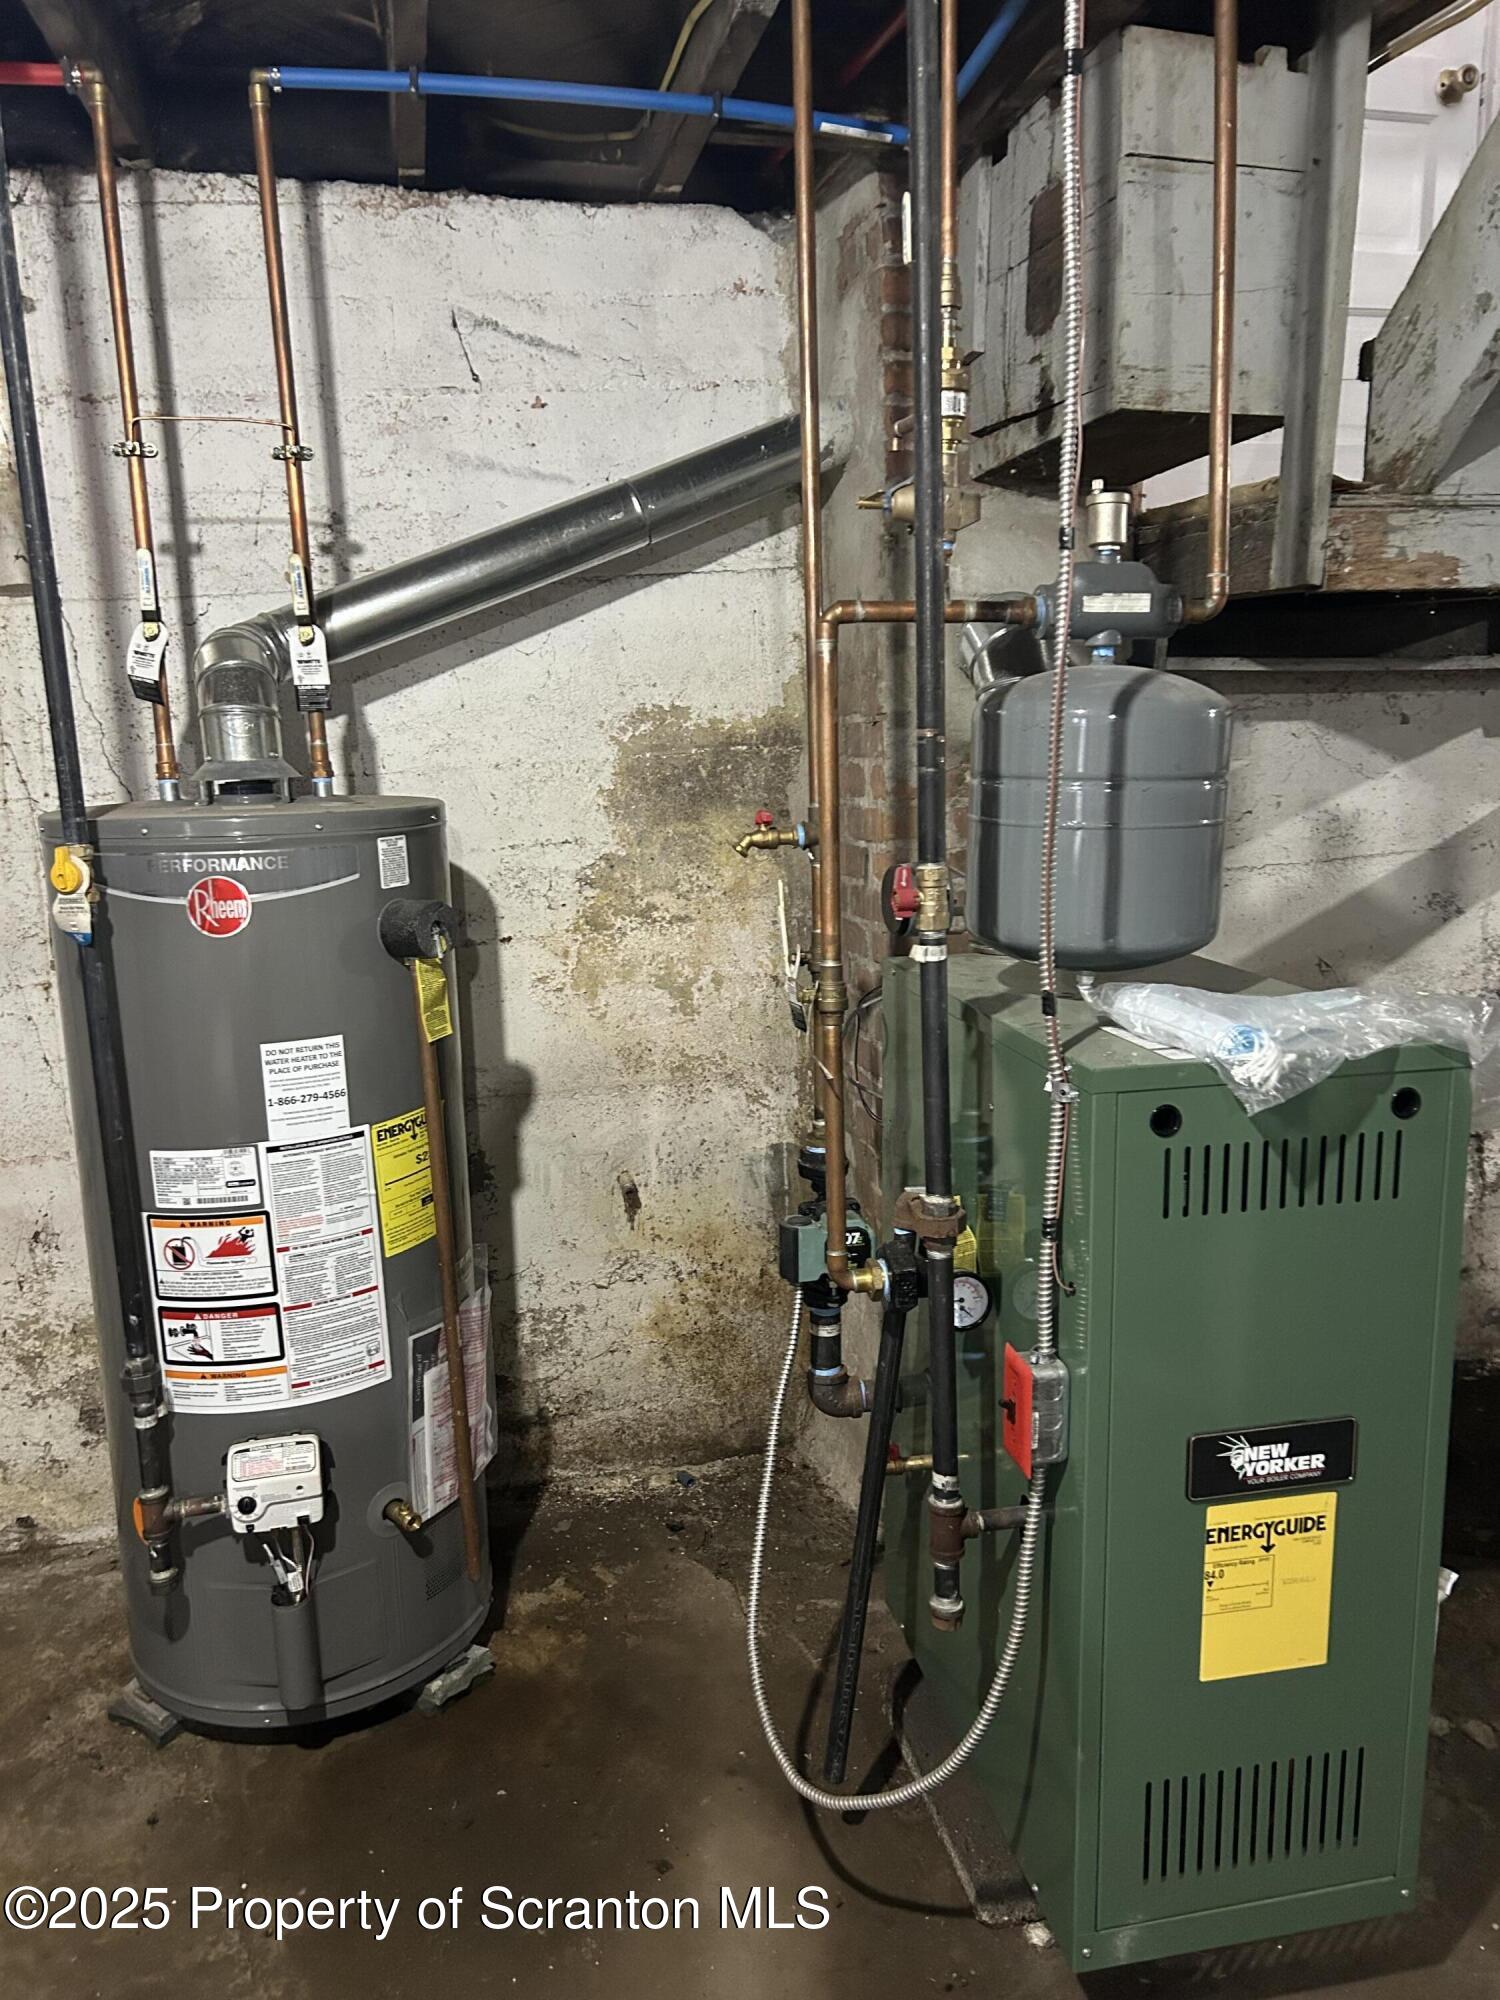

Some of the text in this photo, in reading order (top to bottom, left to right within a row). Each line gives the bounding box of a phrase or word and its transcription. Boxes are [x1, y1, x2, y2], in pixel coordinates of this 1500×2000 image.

[147, 856, 288, 872] PERFORMANCE
[193, 879, 248, 927] Rheem
[279, 1047, 294, 1055] NOT
[296, 1044, 323, 1053] RETURN
[264, 1058, 289, 1066] WATER
[291, 1054, 317, 1063] HEATER
[269, 1066, 291, 1075] PLACE
[304, 1060, 340, 1071] PURCHASE
[267, 1088, 347, 1107] 1-866-279-4566
[377, 1113, 427, 1143] ENERGYGU
[189, 1220, 231, 1228] WARNING
[202, 1312, 239, 1320] DANGER
[210, 1371, 247, 1379] WARNING
[1244, 1442, 1290, 1461] NEW
[1243, 1453, 1326, 1477] YORKER
[1206, 1515, 1326, 1546] ENERGYGUIDE
